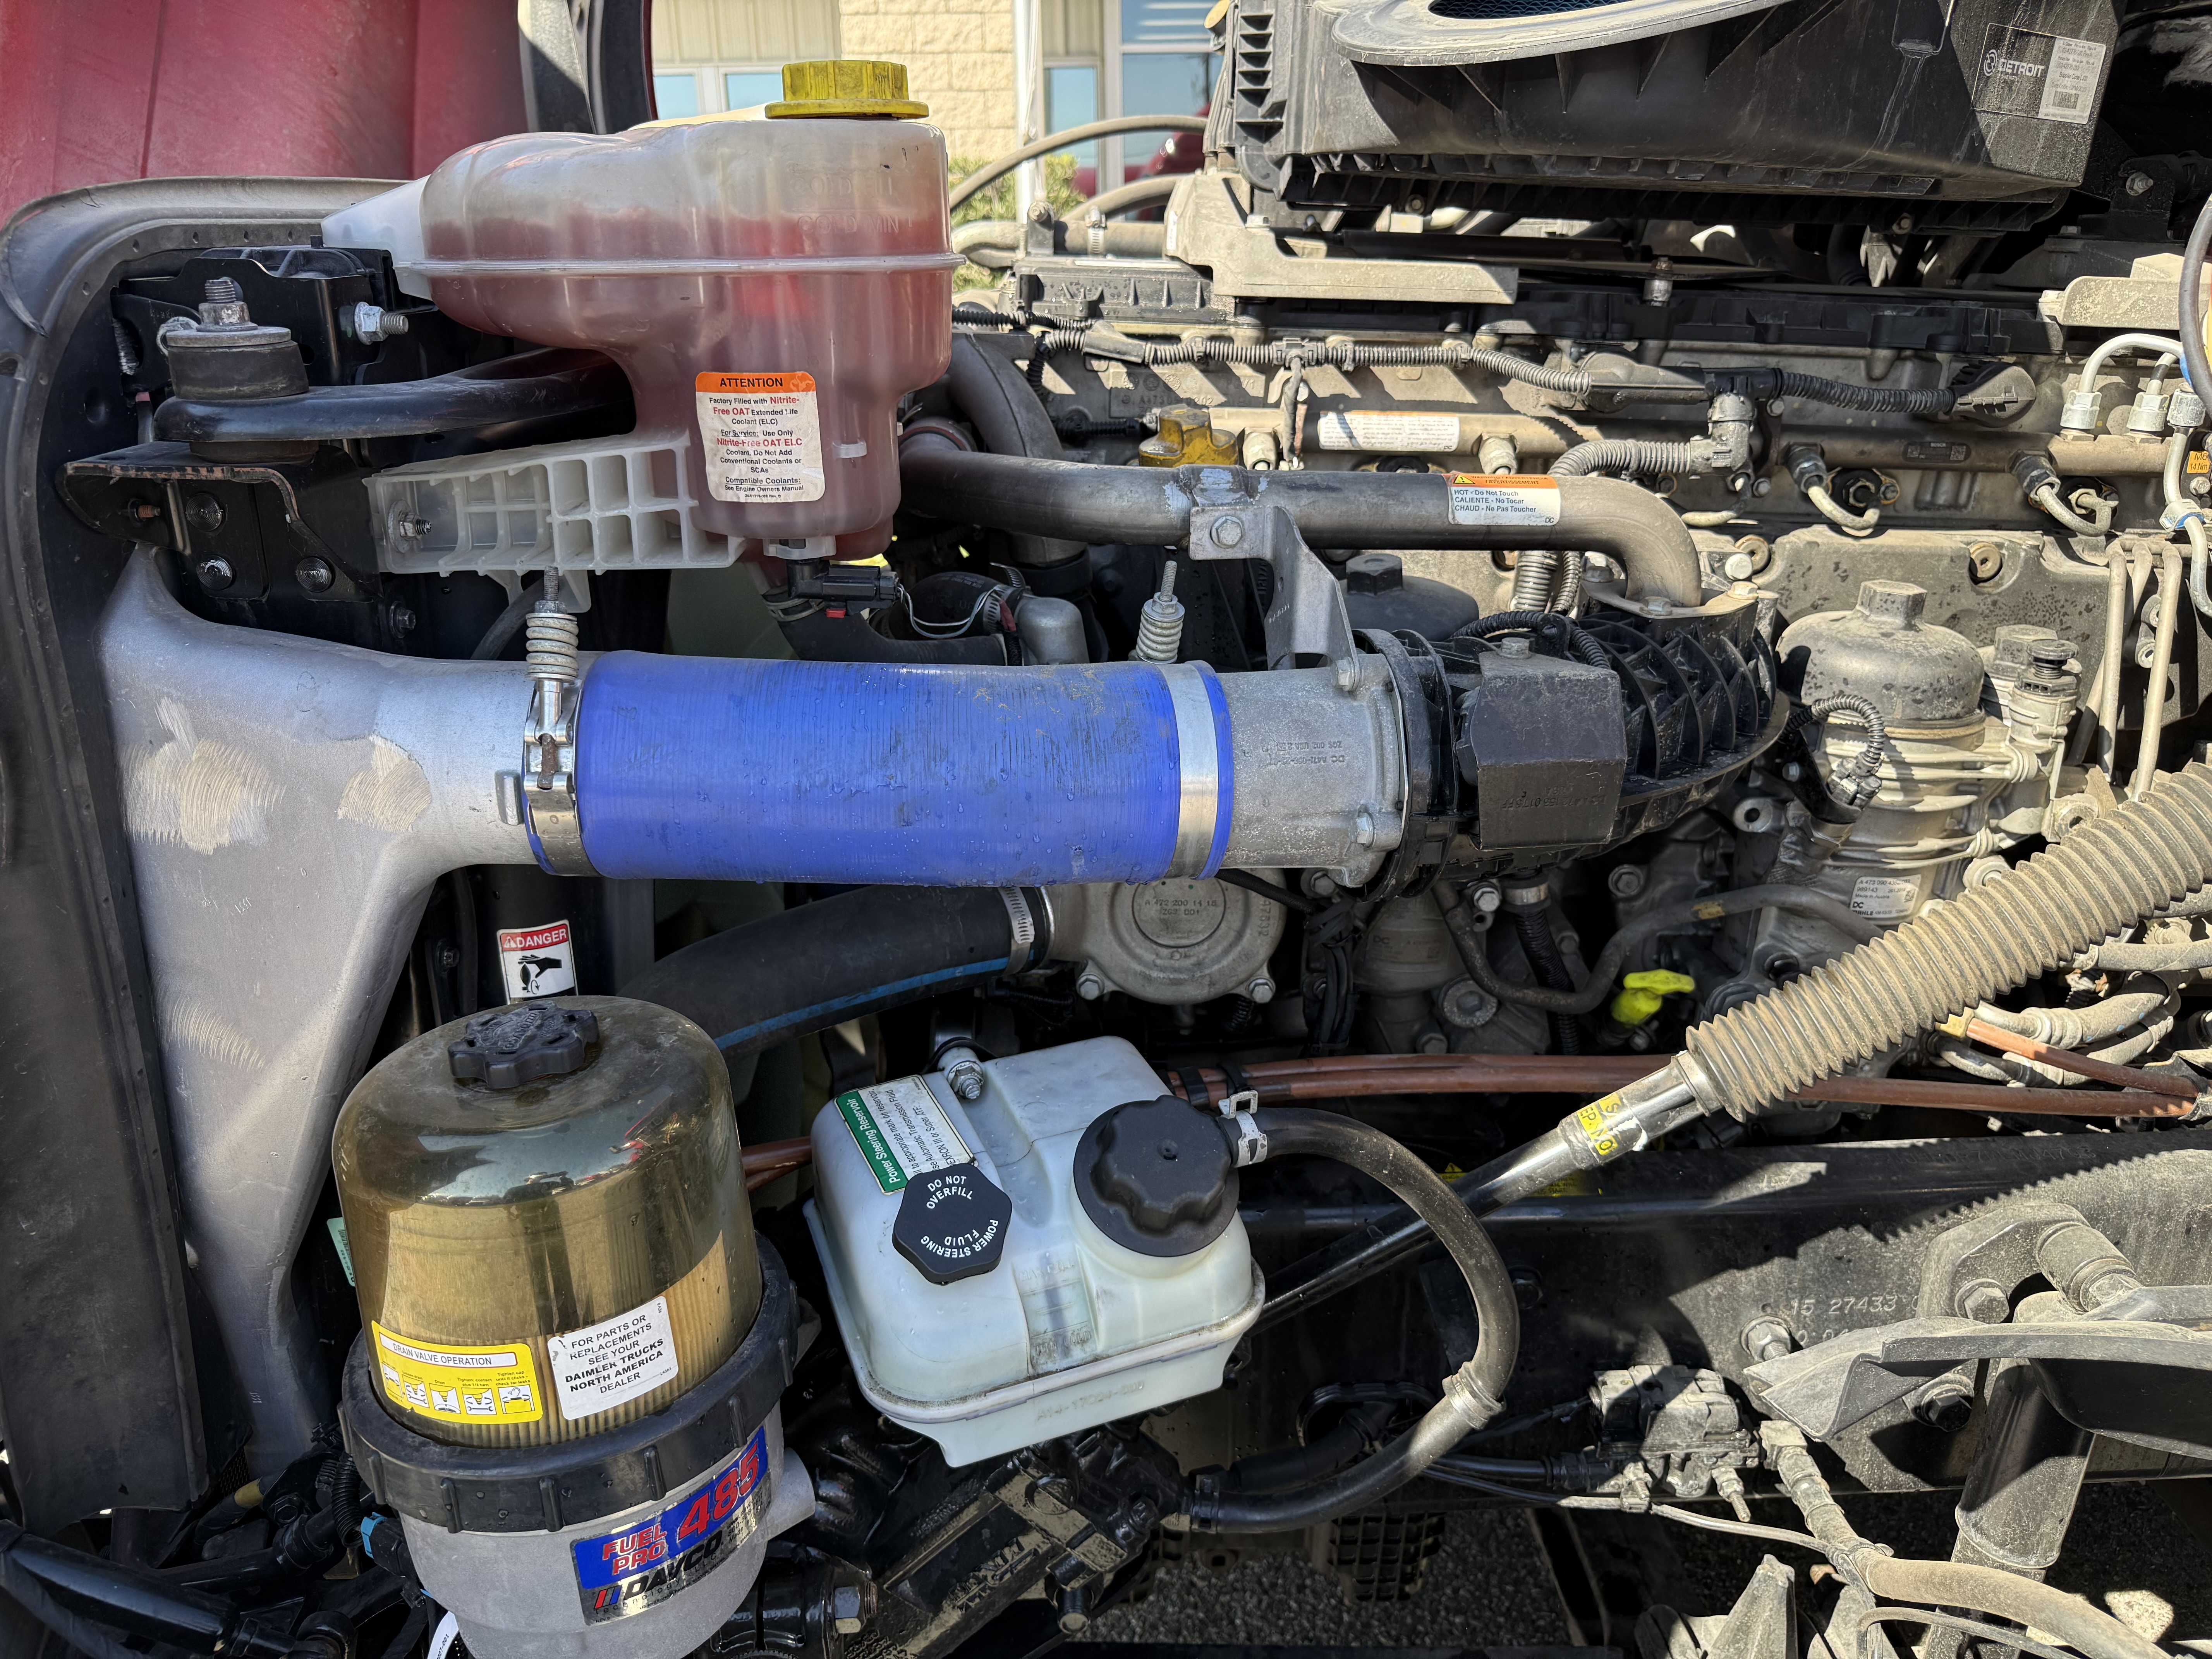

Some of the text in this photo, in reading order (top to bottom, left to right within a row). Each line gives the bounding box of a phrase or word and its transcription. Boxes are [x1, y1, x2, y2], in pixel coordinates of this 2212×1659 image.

[1998, 59, 2044, 77] DETROIT
[720, 378, 783, 387] ATTENTION
[717, 438, 761, 447] Nitrite-Free
[785, 438, 802, 446] ELC
[725, 476, 763, 485] Compatible
[1331, 754, 1345, 763] DC
[516, 929, 567, 948] DANGER
[867, 1089, 886, 1111] reservoir.
[885, 1089, 896, 1103] Fluid
[895, 1102, 918, 1136] Transmission
[913, 1105, 926, 1117] ATF.
[885, 1119, 898, 1133] mark
[921, 1117, 935, 1132] Super
[847, 1098, 900, 1183] Power Steering Reservoir
[894, 1132, 916, 1163] appropriate
[914, 1135, 934, 1162] Automatic
[927, 1175, 967, 1192] DO NOT
[926, 1186, 973, 1209] OVERFILL
[921, 1219, 998, 1258] POWER STEERING
[945, 1229, 979, 1246] FLUID
[1791, 1298, 1815, 1315] 15
[1828, 1295, 1897, 1314] 27433
[570, 1323, 651, 1360] REPLACEMENTS
[572, 1315, 646, 1348] FOR PARTS OR
[393, 1343, 491, 1365] DRAIN VALVE OPERATION
[565, 1338, 663, 1382] DAIMLER TRUCKS
[588, 1340, 640, 1365] SEE YOUR
[570, 1350, 663, 1392] NORTH AMERICA
[600, 1372, 641, 1393] DEALER
[677, 1439, 760, 1544] 485
[603, 1523, 667, 1561] FUEL
[729, 1527, 744, 1544] Made
[612, 1540, 667, 1575] PRO
[623, 1530, 723, 1600] DAYCO
[594, 1578, 680, 1614] Technology
[695, 1554, 716, 1572] LLC
